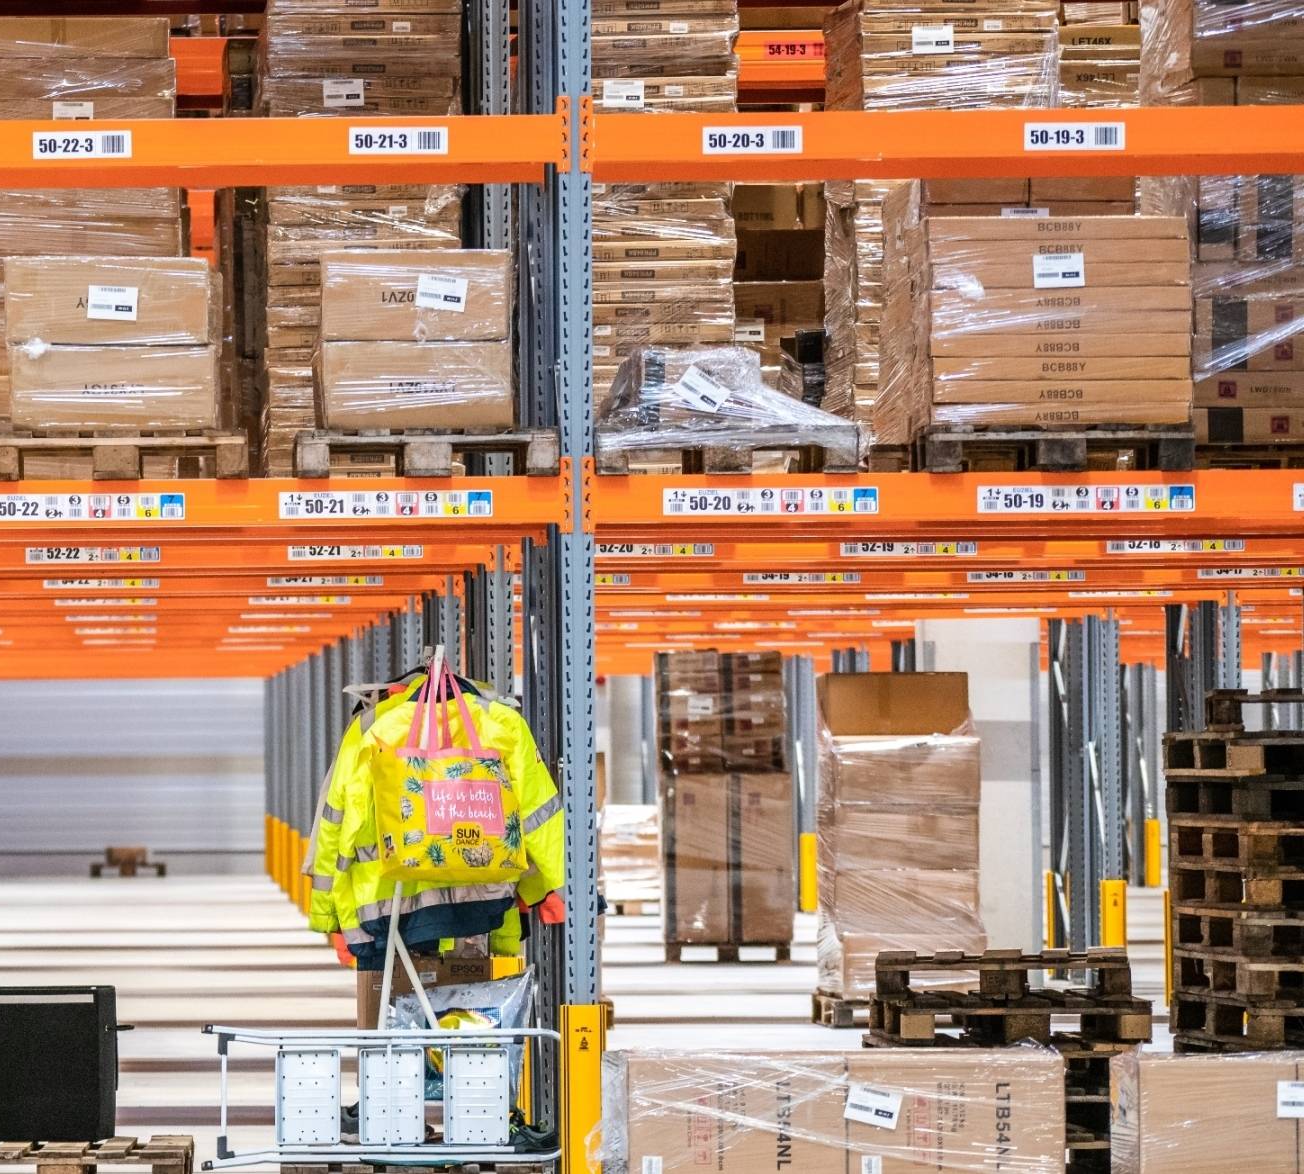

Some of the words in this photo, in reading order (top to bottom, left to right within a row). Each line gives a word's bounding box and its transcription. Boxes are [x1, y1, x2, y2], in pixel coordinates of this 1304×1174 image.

[768, 44, 806, 56] 54-19-3
[354, 133, 408, 149] 50-21-3
[708, 133, 764, 149] 50-20-3
[1030, 129, 1085, 145] 50-19-3
[38, 138, 94, 154] 50-22-3
[1037, 222, 1083, 232] BCB88Y
[1041, 362, 1087, 373] BCB88Y
[306, 499, 346, 513] 50-21
[453, 506, 459, 514] 6
[690, 496, 731, 510] 50-20
[1004, 493, 1046, 508] 50-19
[1154, 501, 1161, 509] 6
[0, 501, 39, 516] 50-22
[145, 509, 151, 517] 6
[46, 547, 80, 560] 52-22
[125, 553, 133, 561] 4
[308, 545, 341, 556] 52-21
[599, 544, 634, 553] 52-20
[861, 542, 894, 552] 52-19
[448, 803, 465, 819] the
[468, 804, 496, 820] beach
[456, 828, 480, 839] SUN
[450, 964, 484, 973] EPSON
